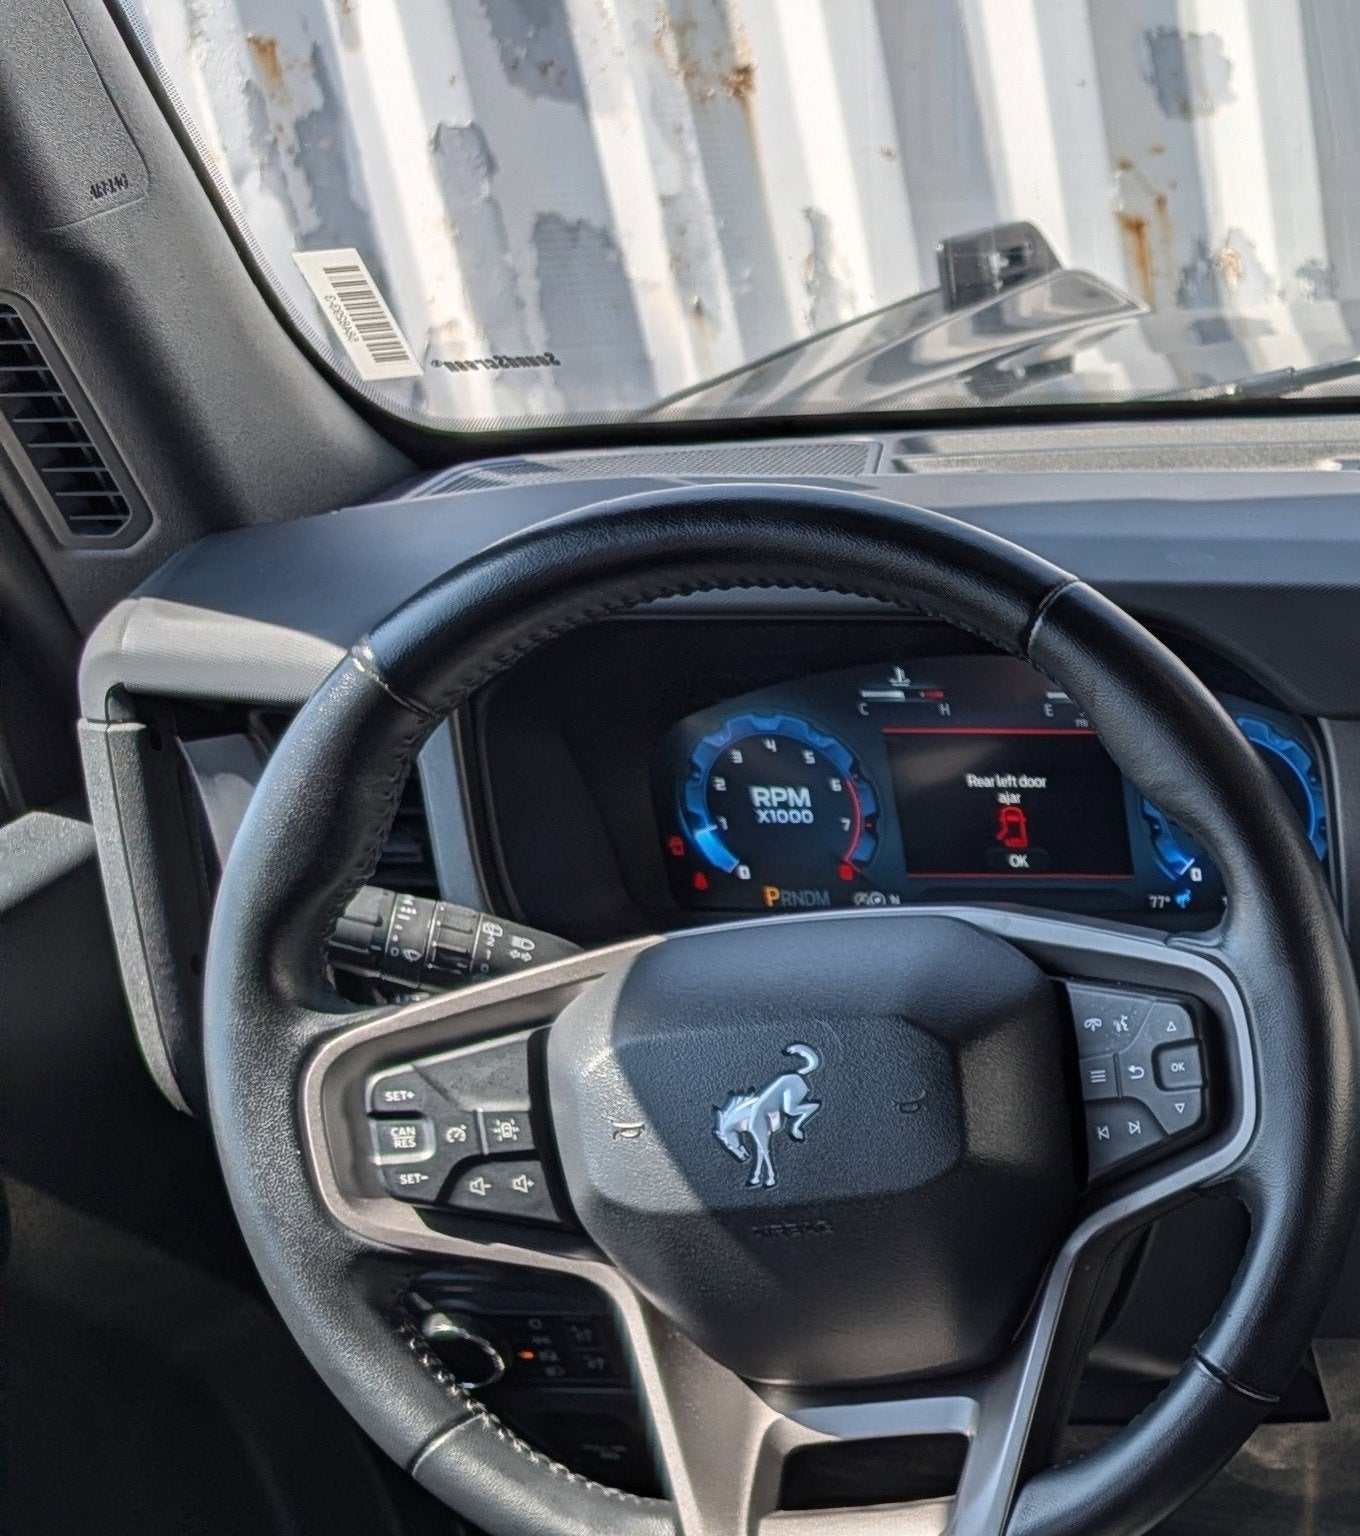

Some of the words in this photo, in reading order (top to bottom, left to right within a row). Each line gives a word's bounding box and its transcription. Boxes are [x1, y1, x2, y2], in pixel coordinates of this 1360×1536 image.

[857, 702, 869, 716] C
[936, 703, 950, 716] H
[1044, 703, 1054, 717] E
[763, 738, 777, 752] 4
[728, 749, 743, 764] 3
[802, 750, 815, 764] 5
[712, 776, 727, 791] 2
[829, 777, 842, 792] 6
[966, 773, 994, 787] Rear
[995, 773, 1018, 787] left
[1019, 774, 1047, 788] door
[751, 786, 811, 808] RPM
[997, 791, 1021, 805] ajar
[717, 815, 728, 830] 1
[840, 817, 850, 831] 7
[755, 809, 814, 824] X1000
[1008, 854, 1029, 868] OK
[736, 864, 751, 880] 0
[1190, 867, 1202, 881] 0
[1171, 1062, 1186, 1072] OK
[390, 1126, 416, 1137] CAN
